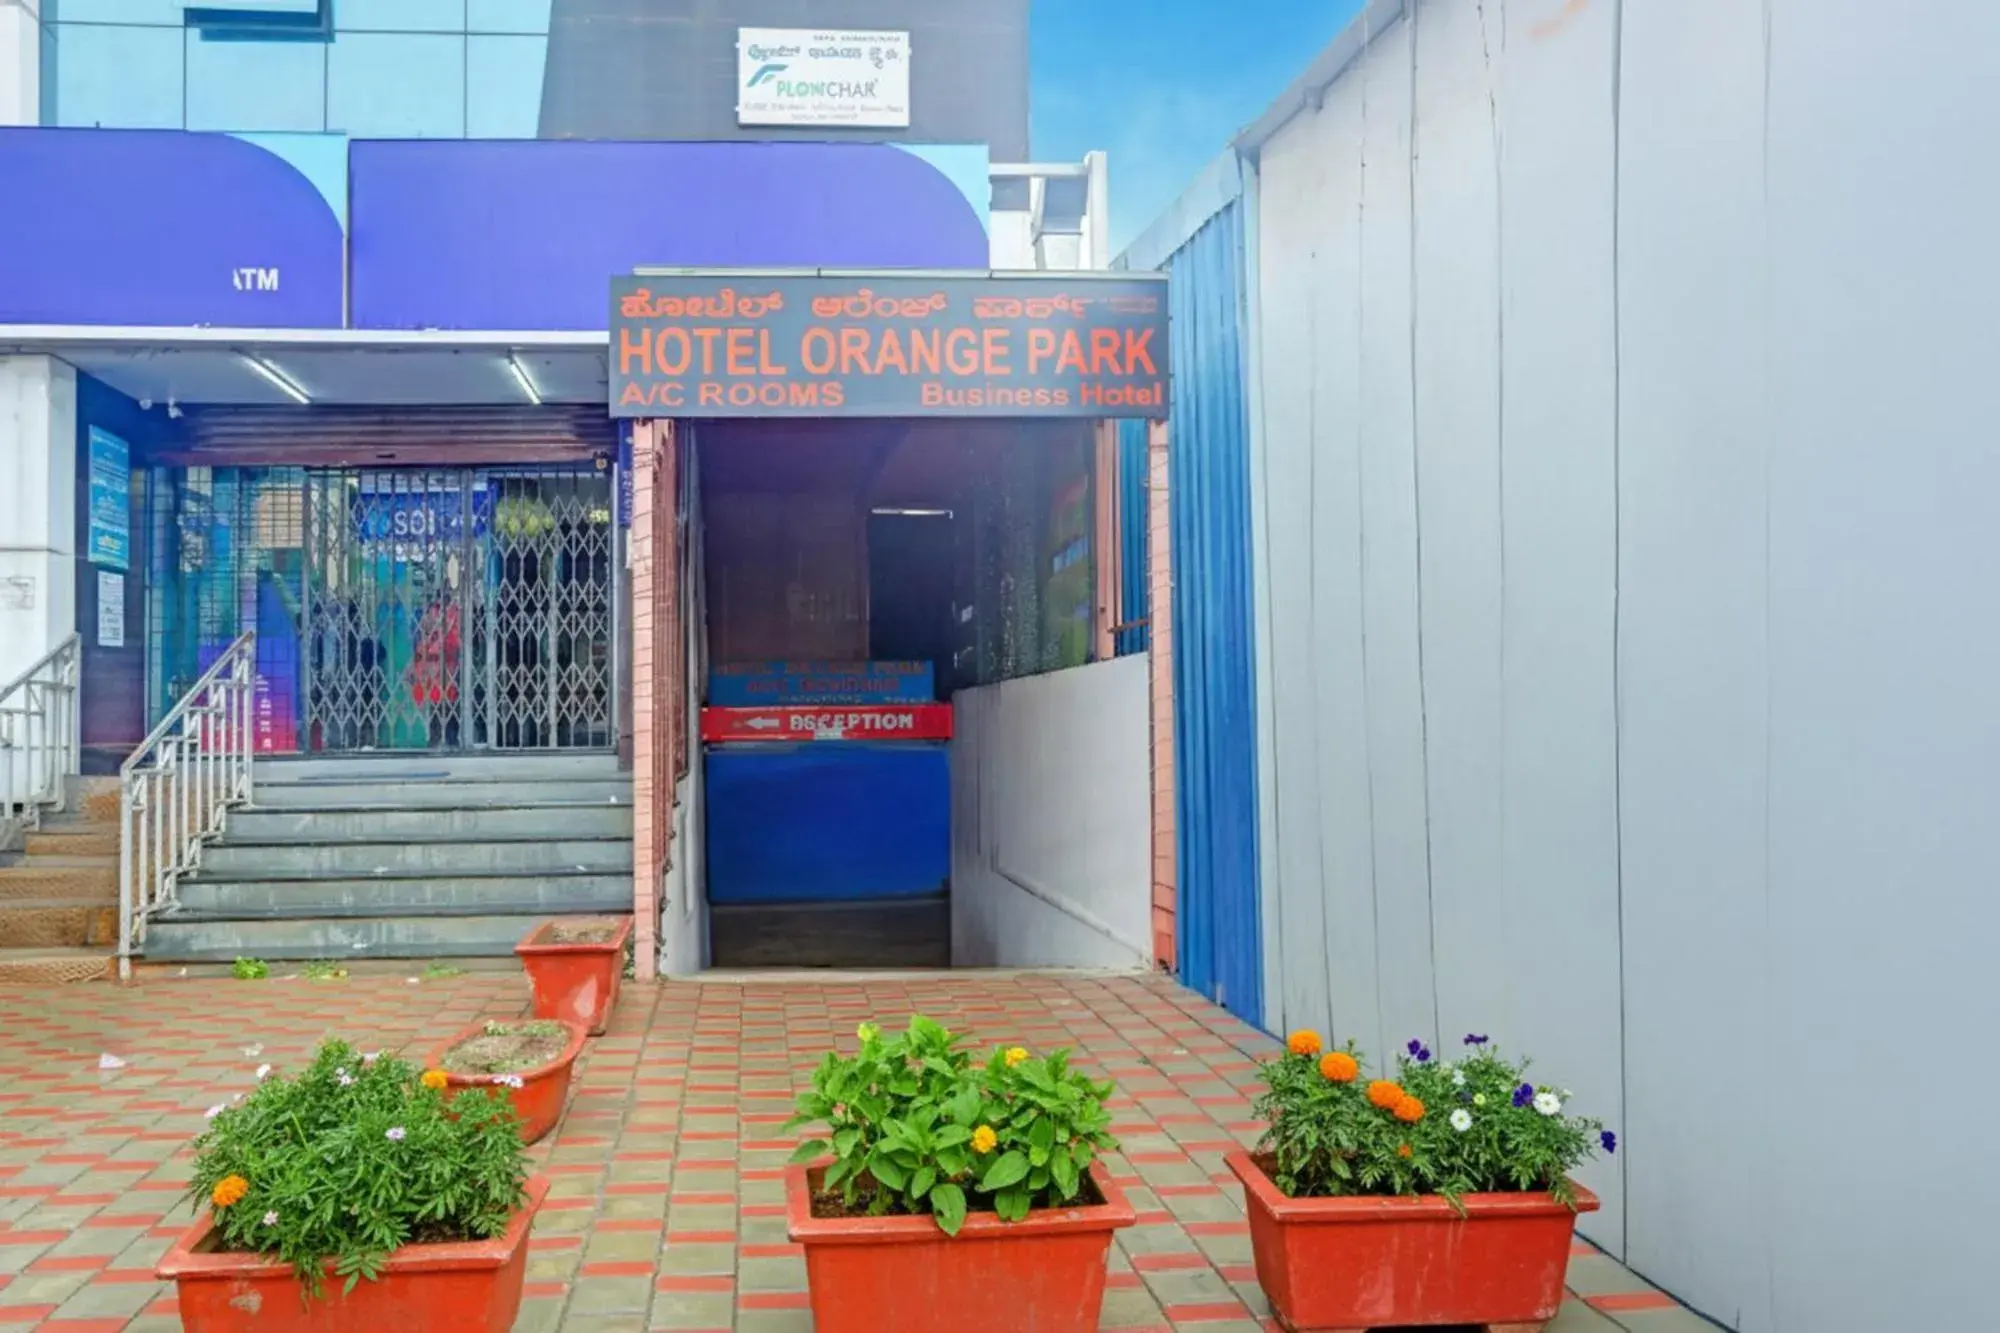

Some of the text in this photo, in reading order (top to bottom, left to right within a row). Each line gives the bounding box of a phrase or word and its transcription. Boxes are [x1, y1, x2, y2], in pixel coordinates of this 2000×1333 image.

[620, 326, 1158, 376] HOTEL ORANGE PARK
[619, 382, 845, 406] A/C ROOMS
[920, 381, 1162, 406] Business Hotel
